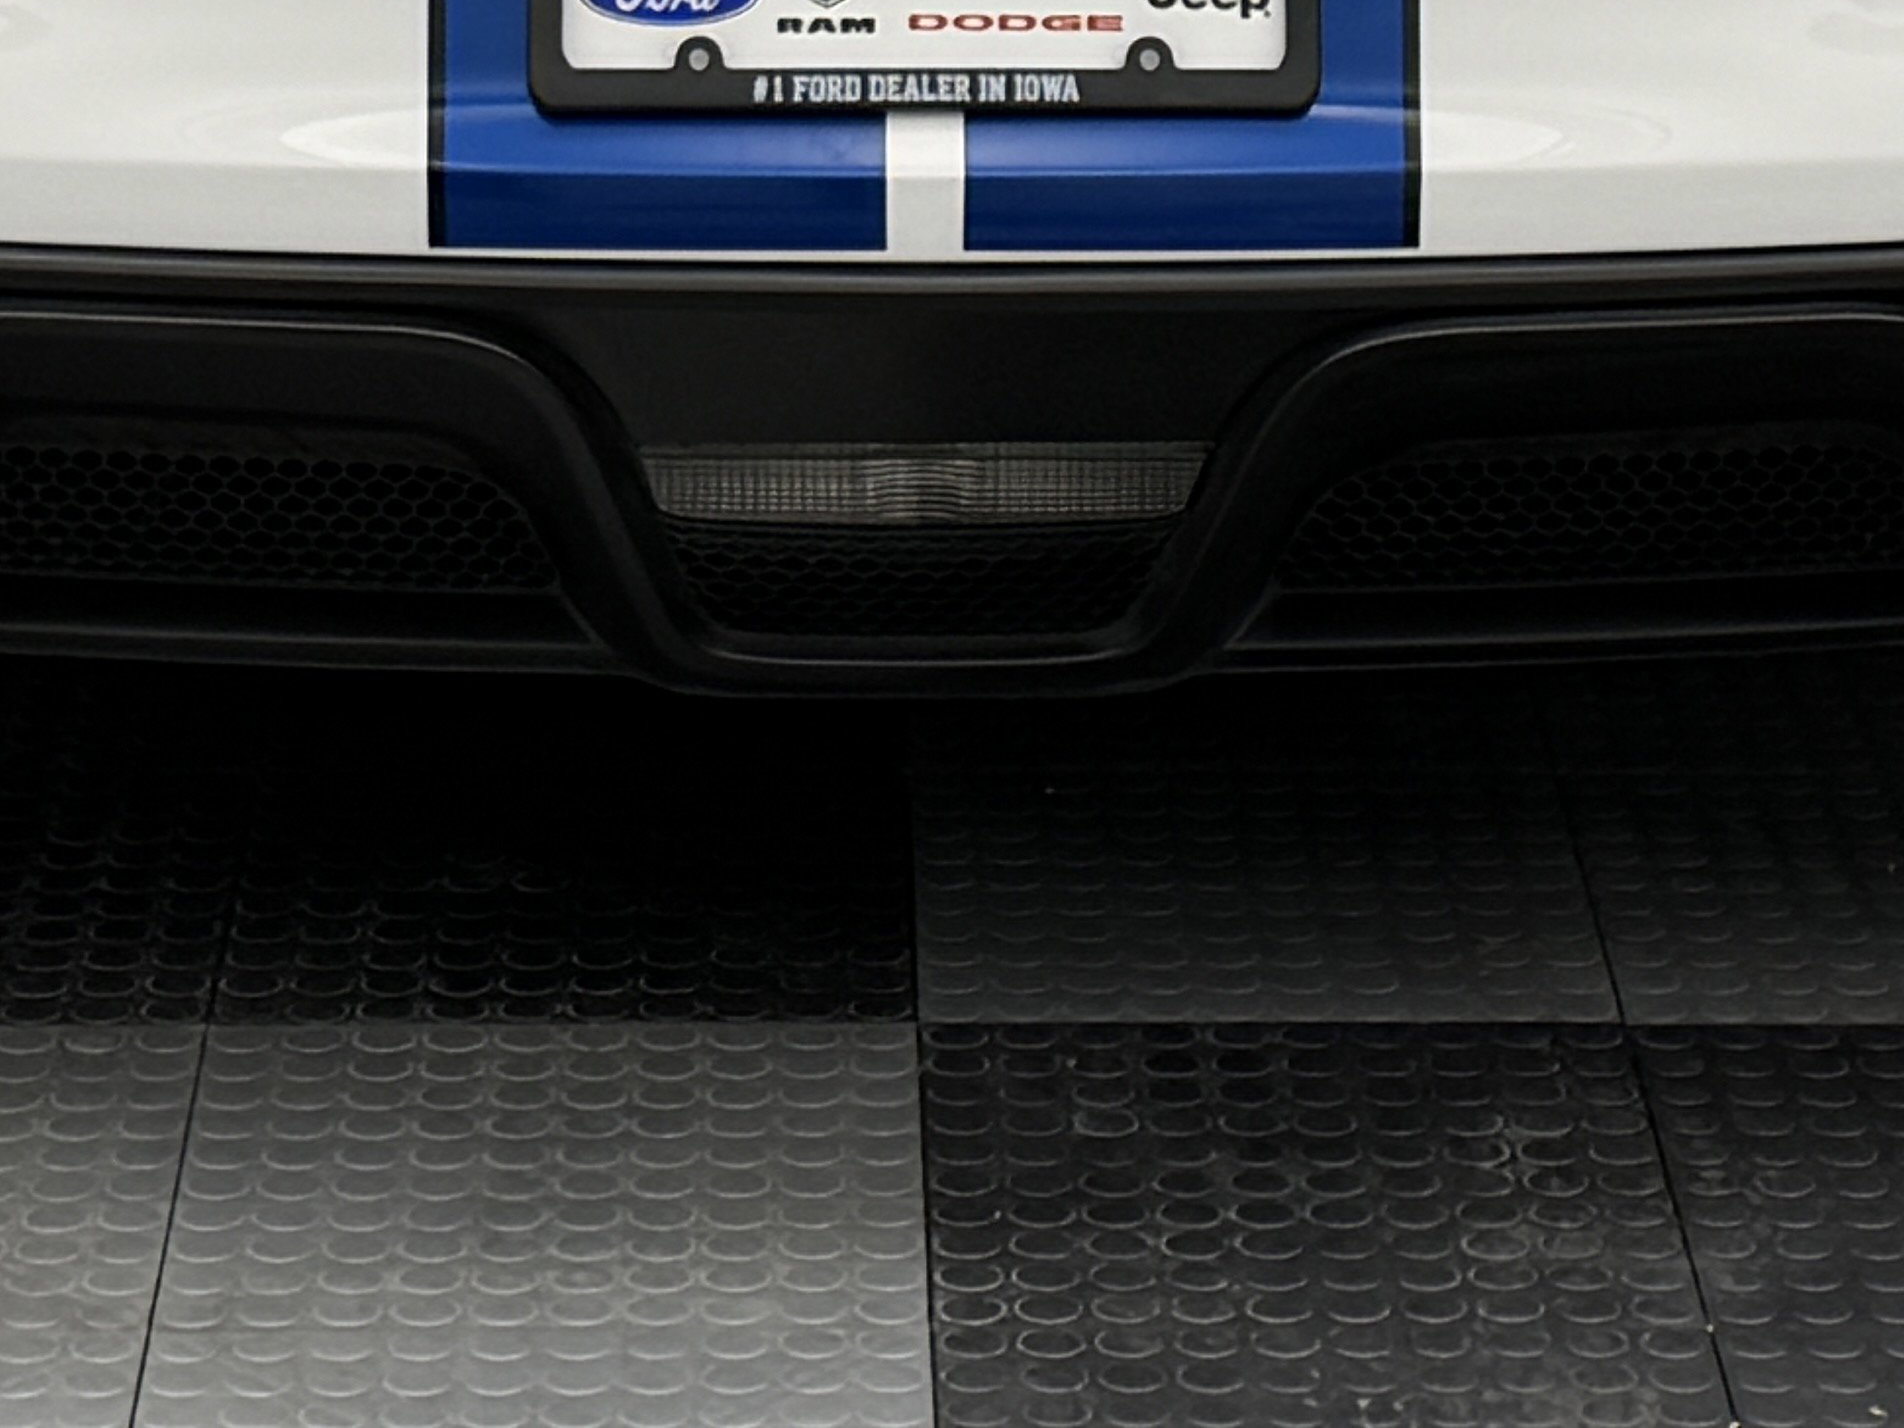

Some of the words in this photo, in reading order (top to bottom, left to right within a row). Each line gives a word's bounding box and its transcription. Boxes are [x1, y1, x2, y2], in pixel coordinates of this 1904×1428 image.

[777, 17, 876, 34] RAM
[908, 14, 1124, 32] DODGE
[754, 77, 784, 103] #1
[792, 77, 862, 103] FORD
[869, 76, 972, 103] DEALER
[979, 76, 1007, 102] IN
[1013, 76, 1079, 103] IOWA
